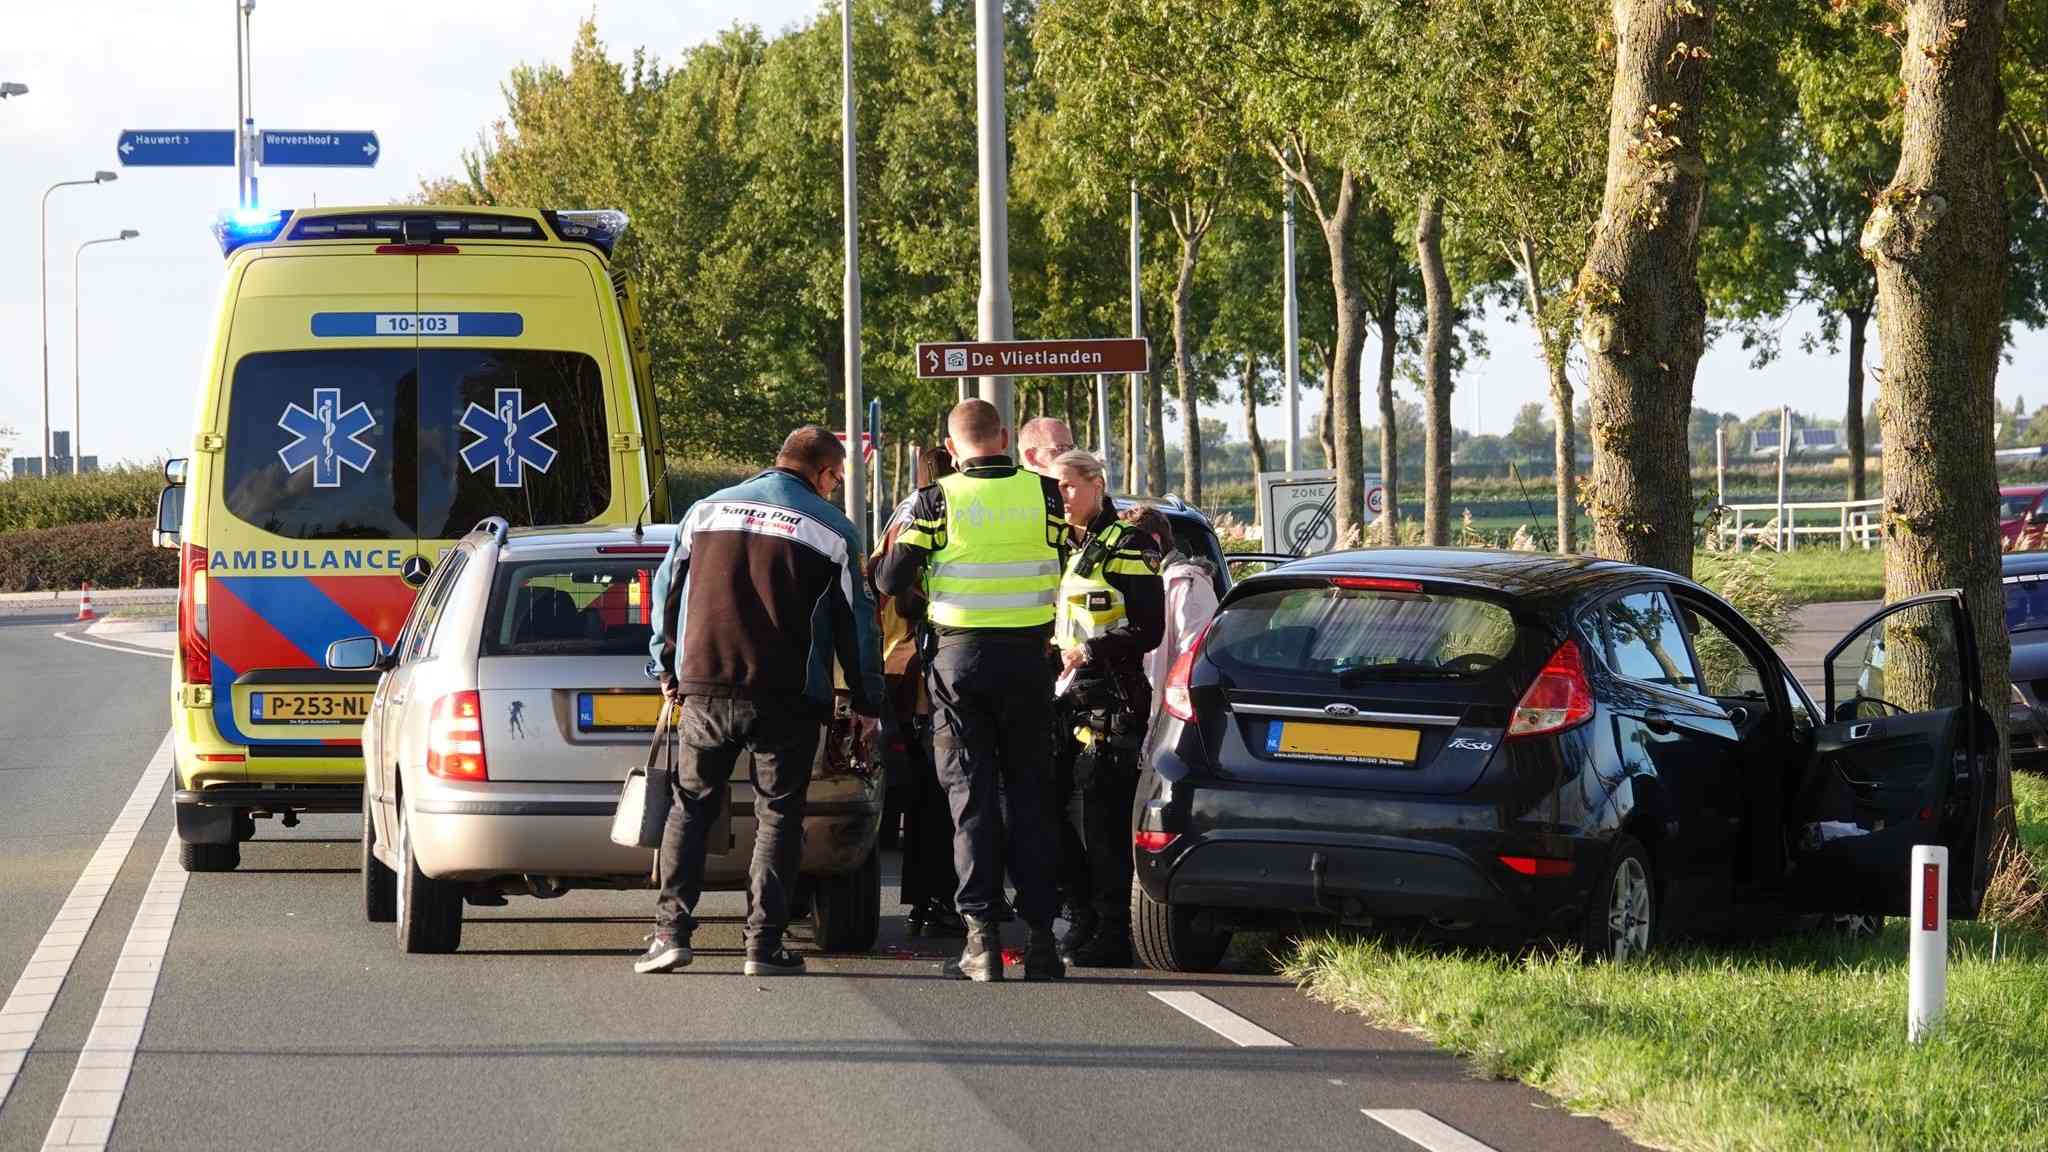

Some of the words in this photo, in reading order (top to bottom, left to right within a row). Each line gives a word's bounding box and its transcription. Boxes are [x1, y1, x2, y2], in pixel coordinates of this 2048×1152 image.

[136, 135, 181, 145] Hauwert
[183, 137, 190, 145] 3
[266, 135, 331, 146] Wervershoof
[333, 137, 340, 145] 2
[388, 317, 447, 332] 10-103
[972, 352, 994, 367] De
[1000, 349, 1102, 367] Vlietlanden
[1291, 487, 1326, 499] ZONE
[721, 505, 767, 518] Santa
[771, 511, 802, 526] Pod
[1294, 520, 1329, 541] 60
[210, 550, 401, 570] AMBULANCE
[272, 697, 369, 716] P-253-NL
[581, 712, 592, 721] NL
